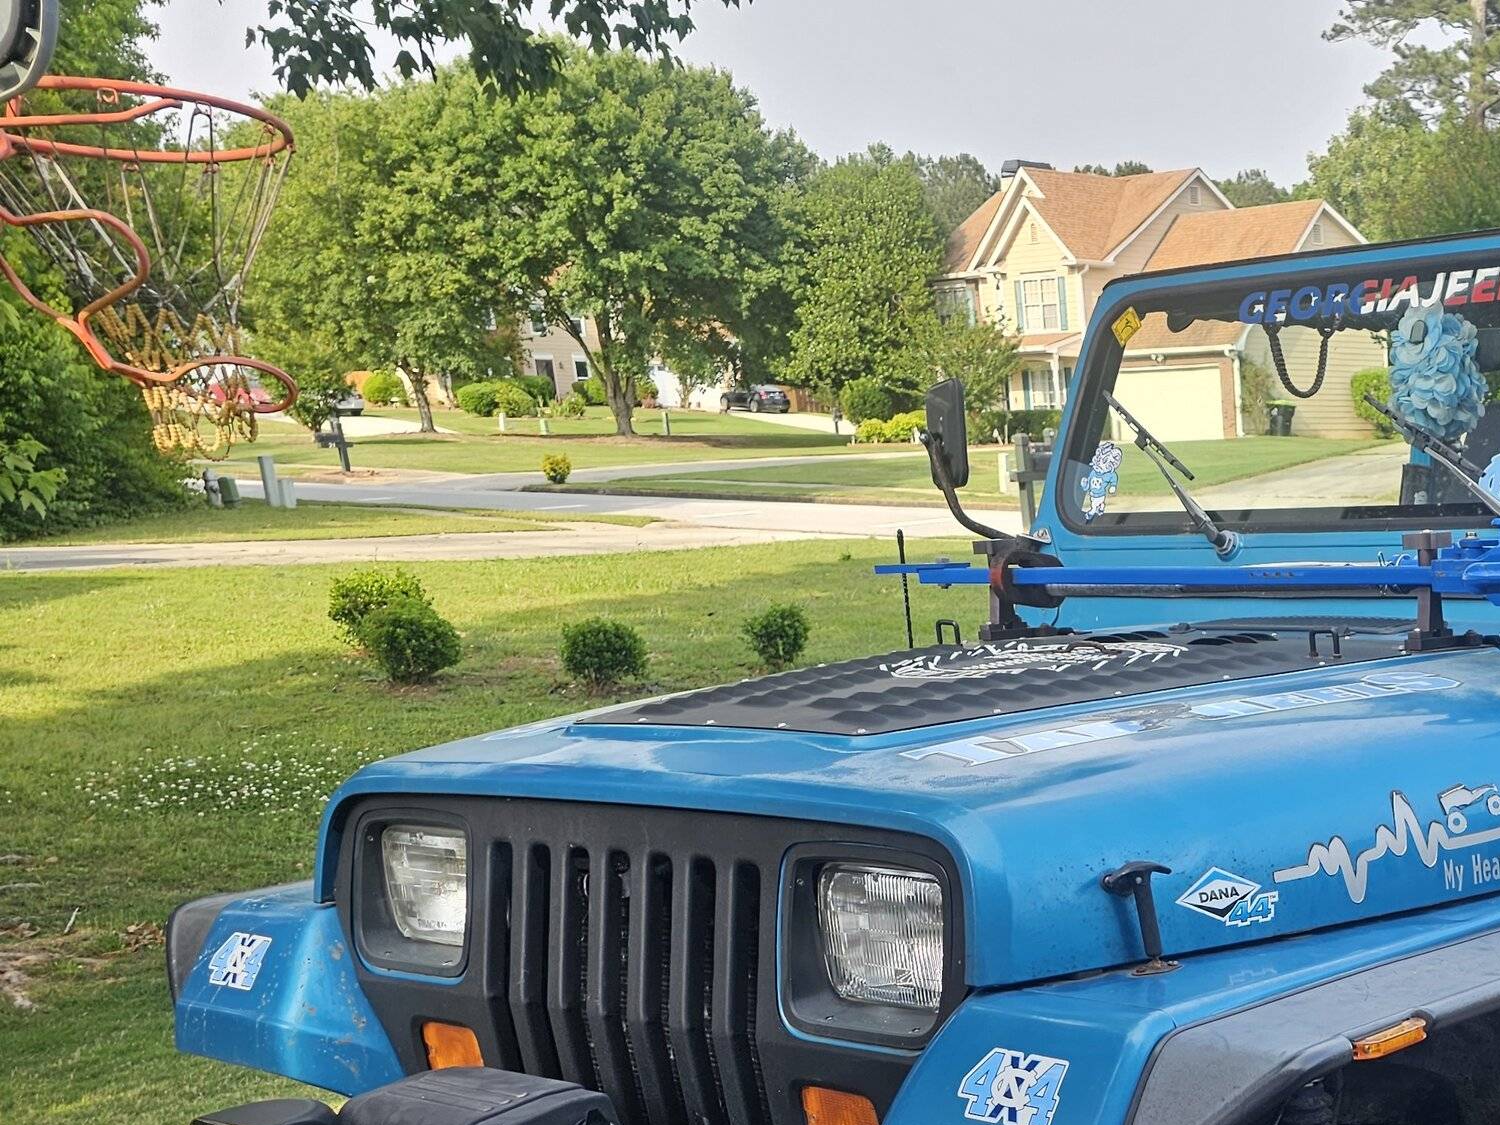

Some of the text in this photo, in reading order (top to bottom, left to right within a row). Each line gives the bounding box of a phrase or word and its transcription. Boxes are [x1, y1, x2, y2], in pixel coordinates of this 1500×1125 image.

[1443, 859, 1464, 892] My
[1198, 886, 1272, 924] DANA 44
